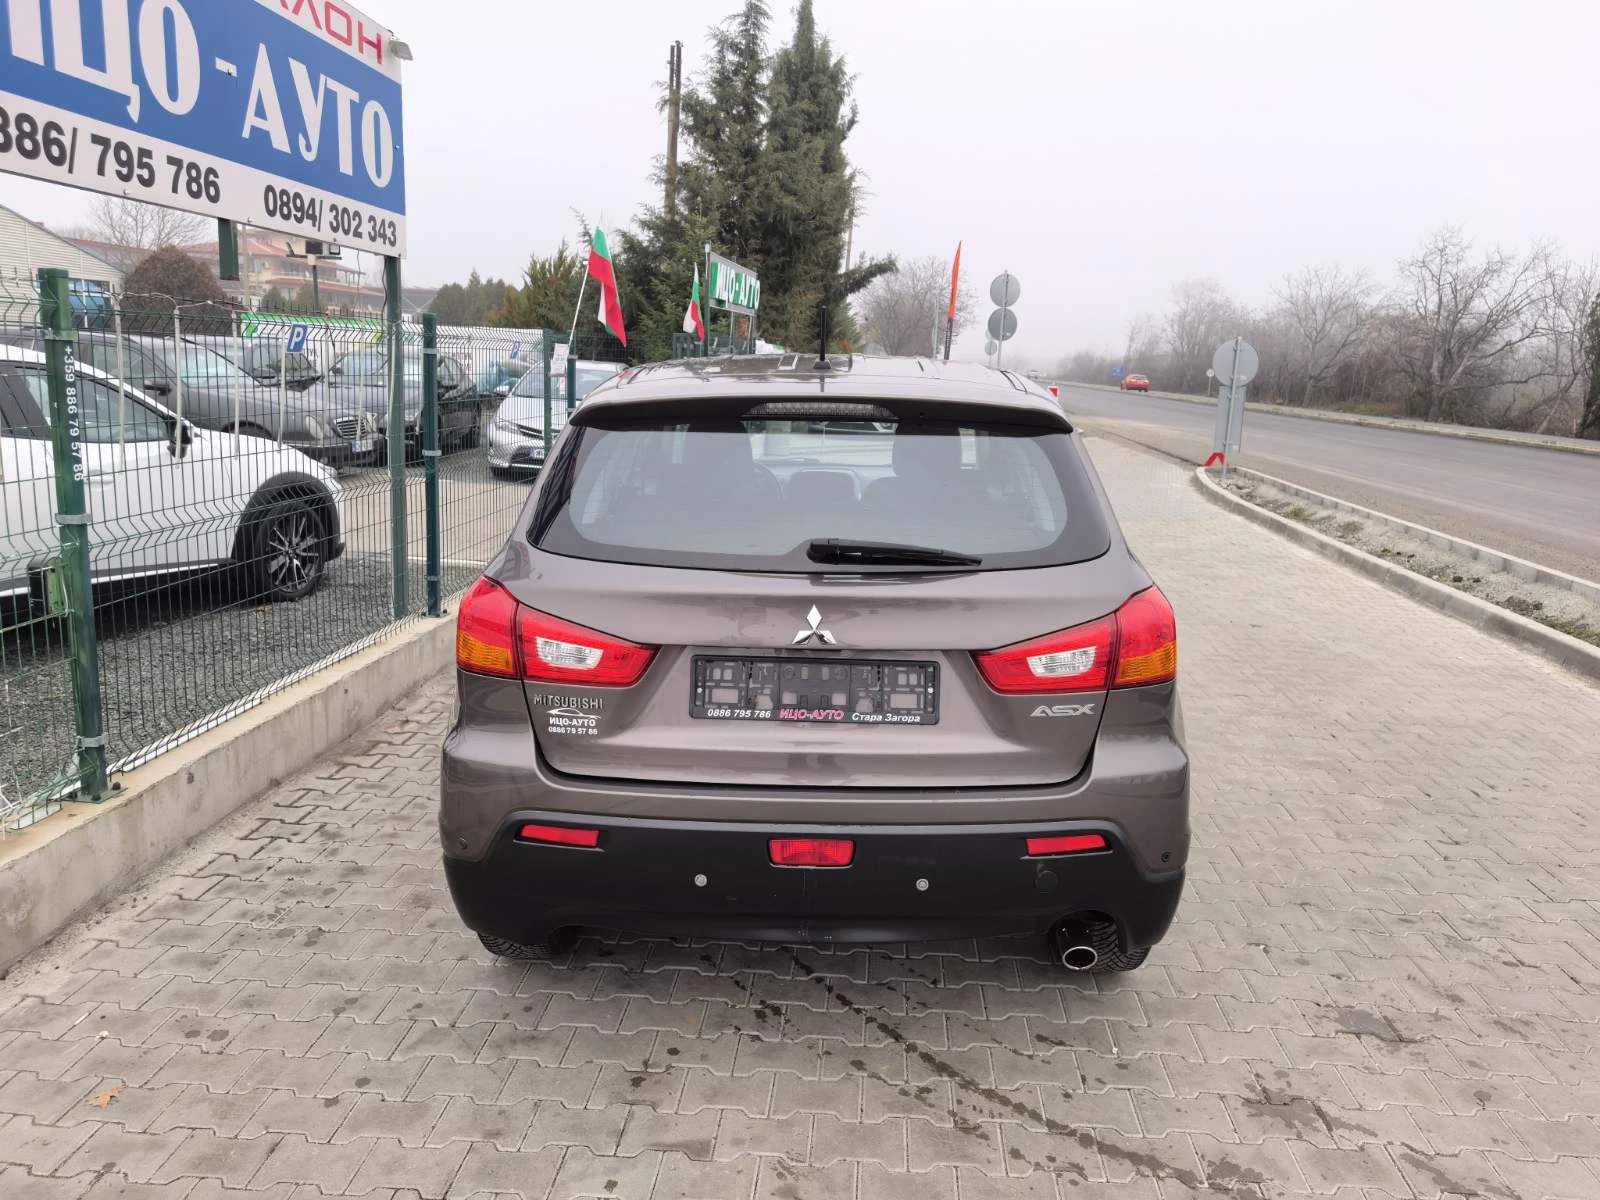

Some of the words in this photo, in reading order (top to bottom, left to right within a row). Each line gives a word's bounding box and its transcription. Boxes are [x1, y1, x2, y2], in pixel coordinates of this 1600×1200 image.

[90, 133, 156, 188] 795
[166, 155, 221, 204] 786
[263, 184, 323, 232] 0894/
[329, 204, 363, 239] 302
[367, 215, 397, 247] 343
[289, 326, 304, 350] P
[64, 345, 75, 382] +359
[66, 387, 78, 414] 886
[69, 420, 80, 437] 79
[71, 441, 82, 457] 57
[73, 464, 84, 481] 86
[533, 694, 603, 709] MITSUBISHI
[707, 708, 730, 717] 0886
[733, 709, 751, 718] 795
[754, 710, 771, 719] 786
[780, 708, 844, 720] ИЦО-АУТО
[852, 712, 882, 722] Стара
[885, 713, 921, 723] Загора
[1030, 703, 1096, 717] ASX
[549, 717, 596, 727] ИЦО-АУТО
